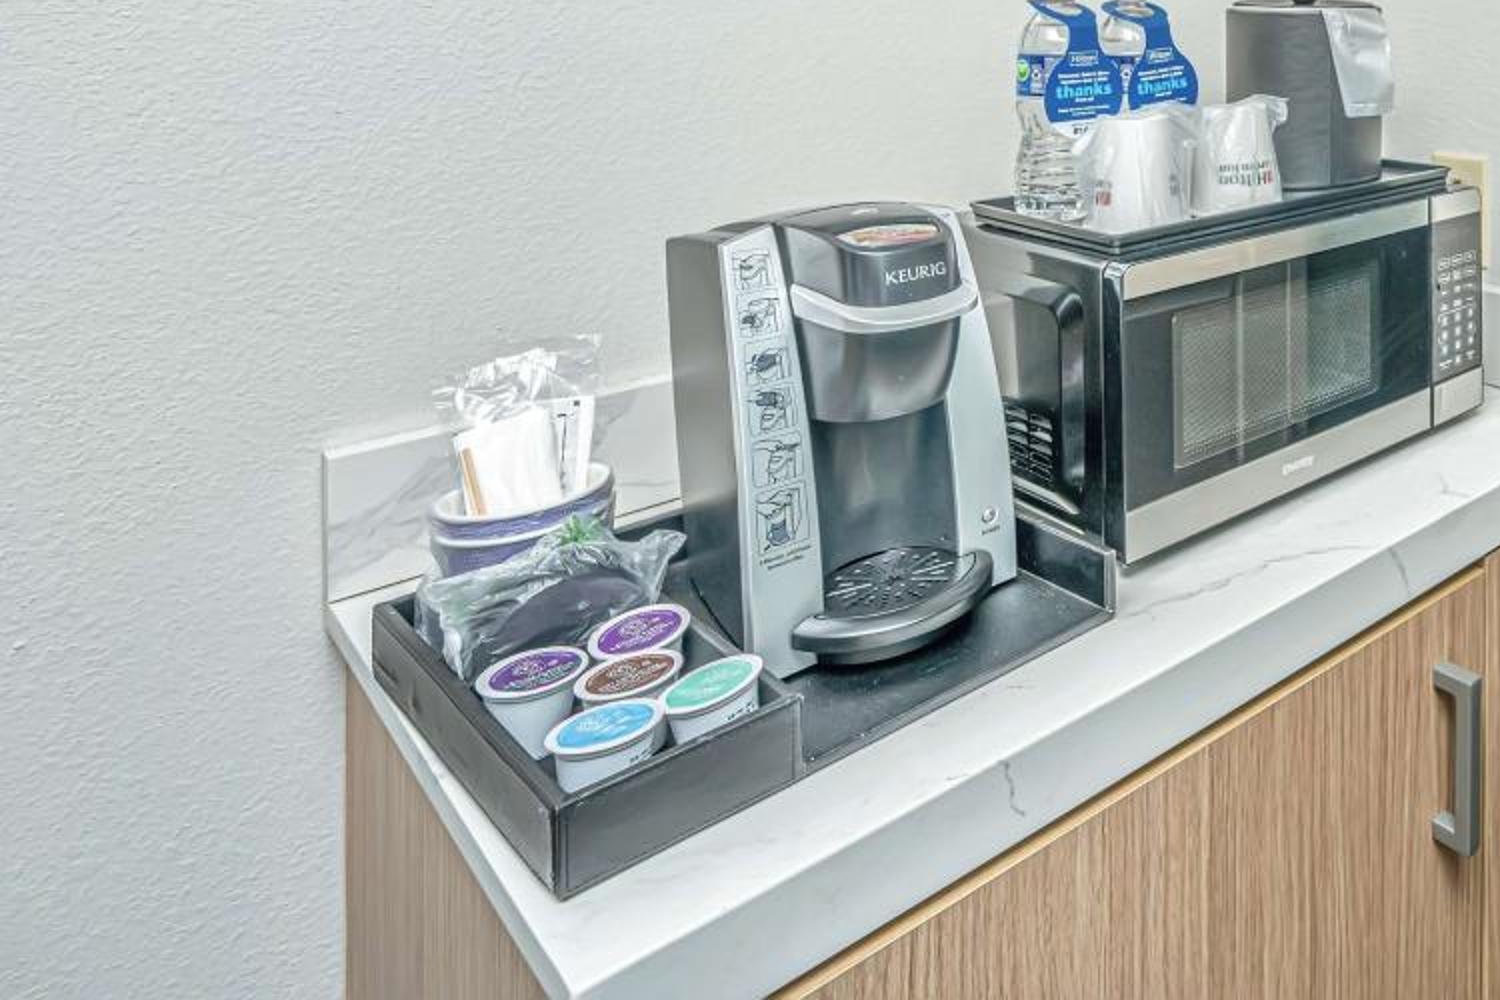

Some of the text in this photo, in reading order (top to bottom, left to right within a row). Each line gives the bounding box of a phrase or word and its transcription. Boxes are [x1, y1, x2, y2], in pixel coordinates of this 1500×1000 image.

[1056, 82, 1112, 99] thanks
[1137, 77, 1187, 95] thanks
[885, 261, 946, 286] KEURIG
